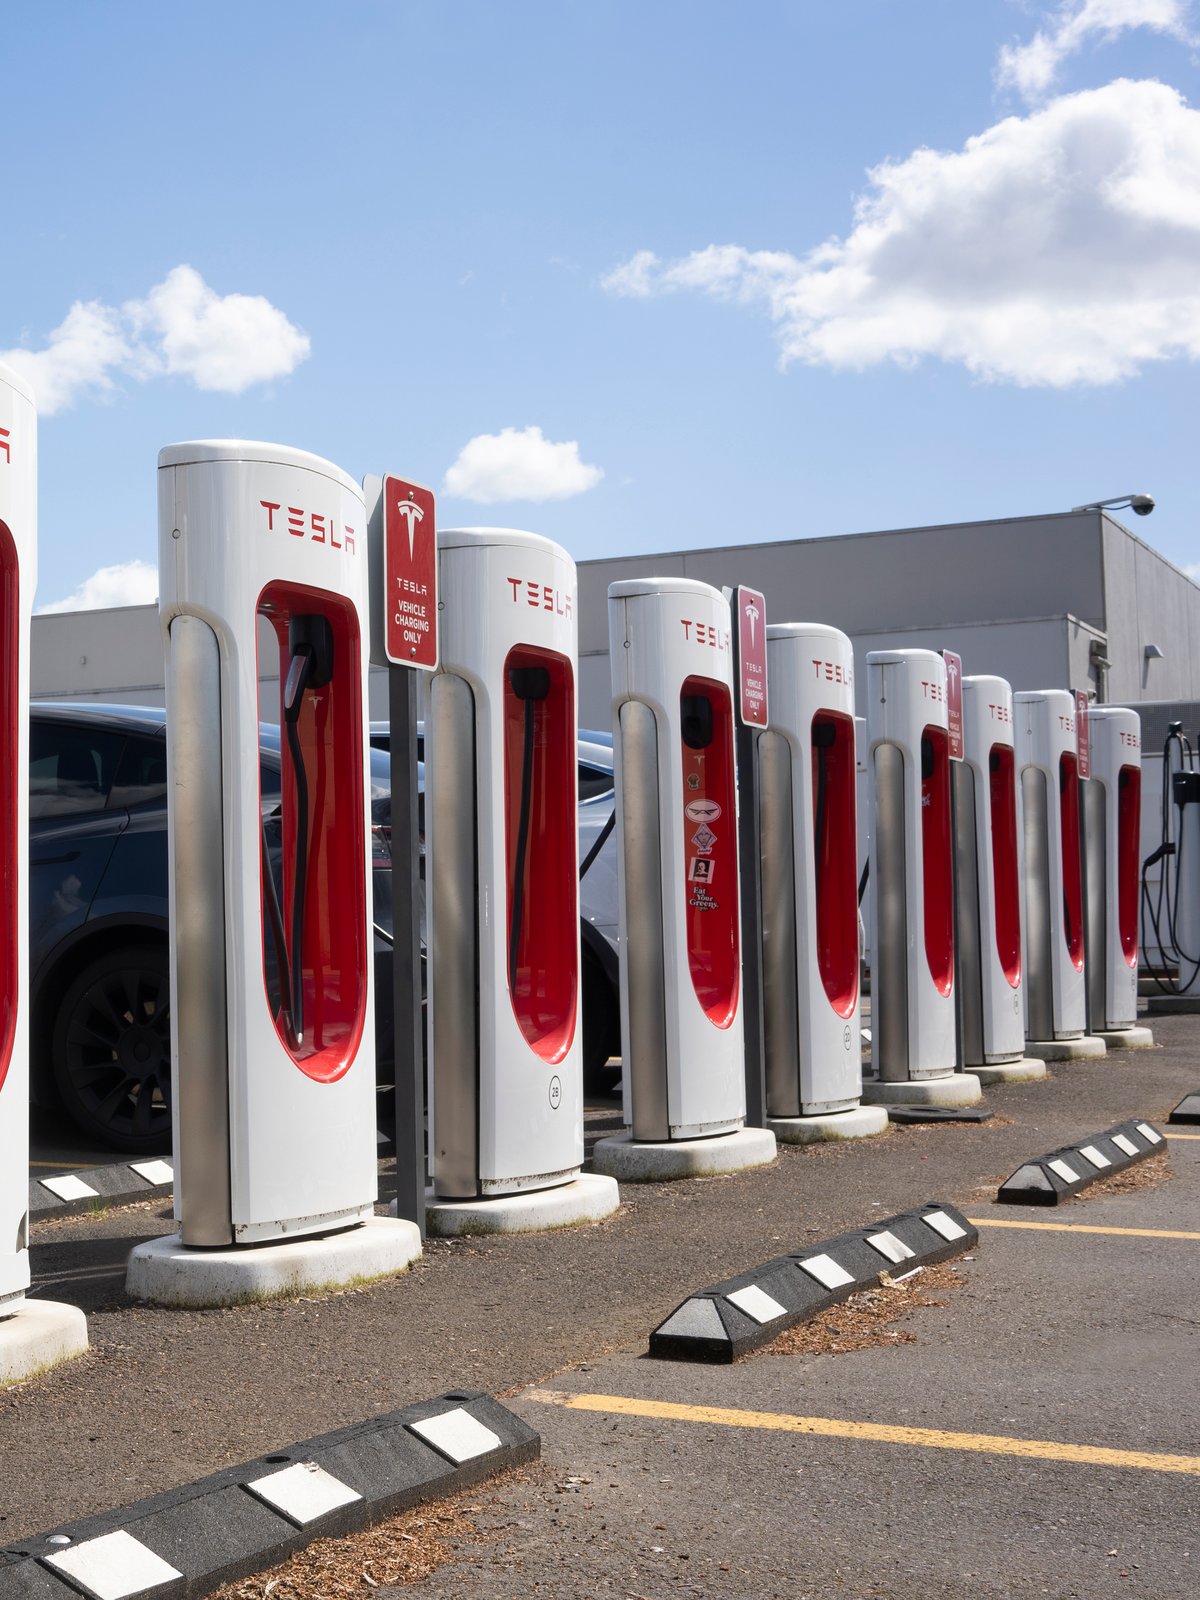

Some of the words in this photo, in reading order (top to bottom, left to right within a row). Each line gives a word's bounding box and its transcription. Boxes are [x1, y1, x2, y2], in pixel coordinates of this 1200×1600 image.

[259, 500, 355, 556] TESLA
[396, 577, 427, 596] TESLA
[398, 599, 426, 618] VEHICLE
[506, 577, 573, 621] TESLA
[394, 613, 430, 633] CHARGING
[403, 629, 422, 645] ONLY
[551, 1086, 560, 1098] 2B
